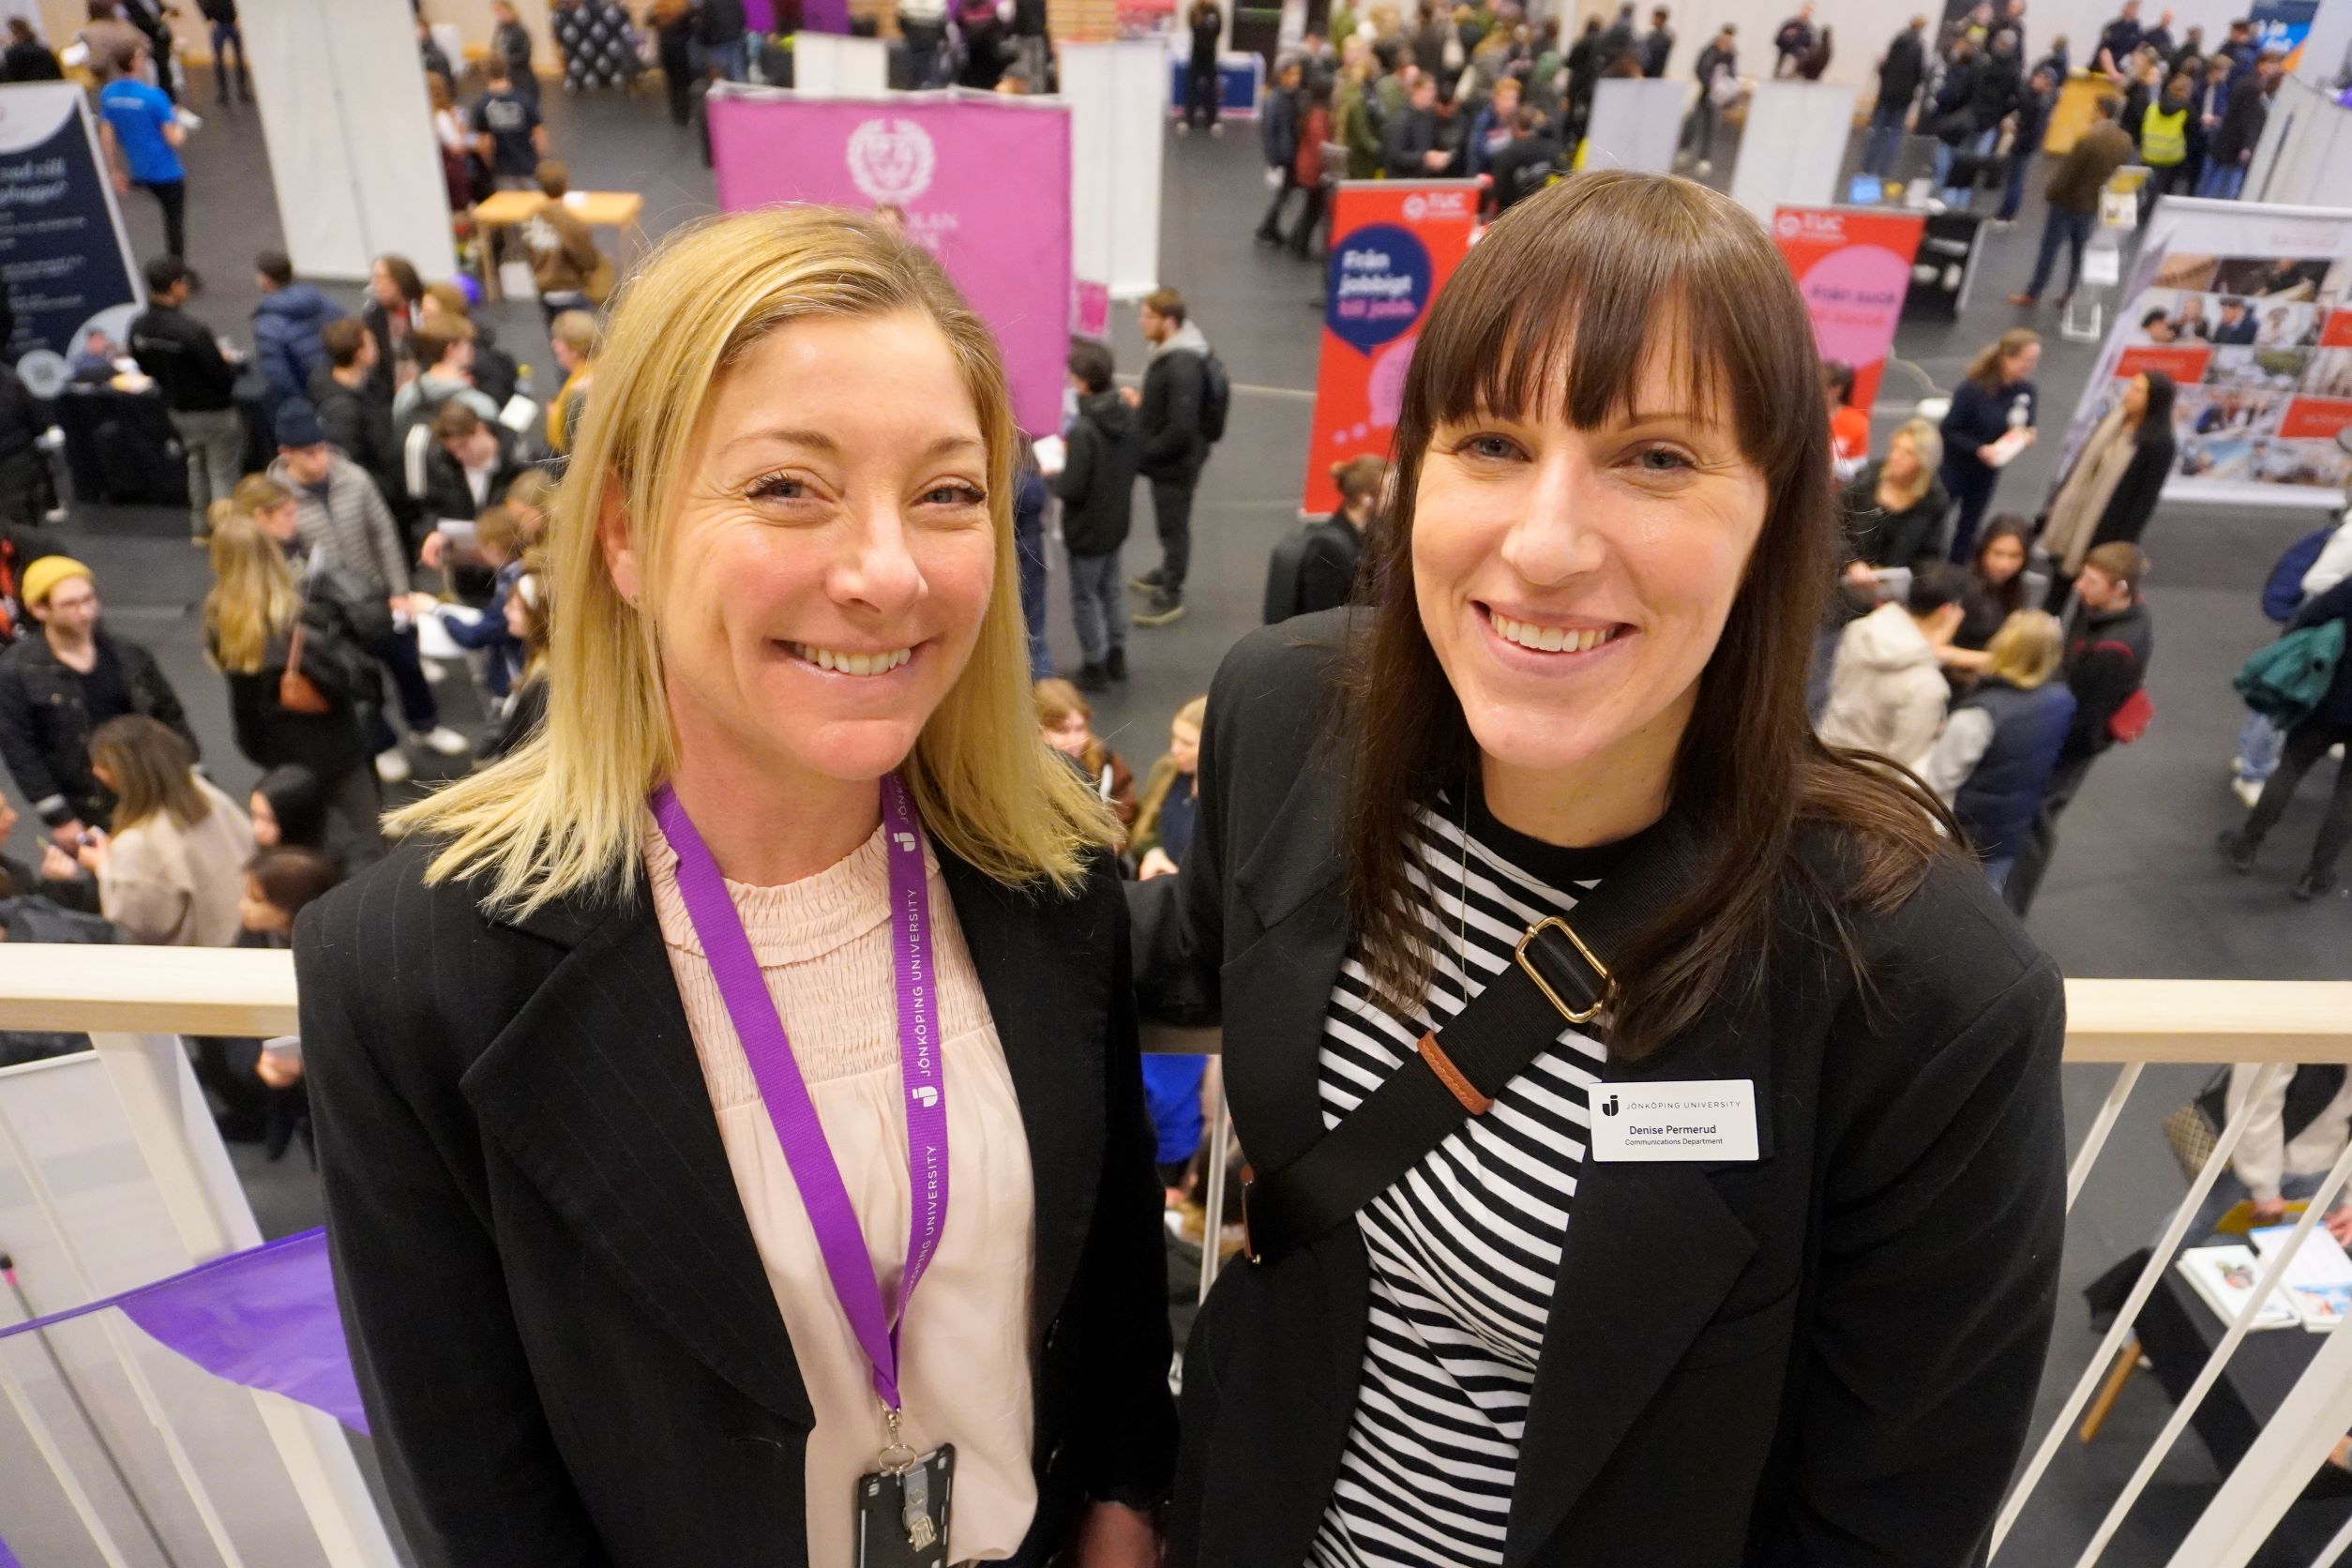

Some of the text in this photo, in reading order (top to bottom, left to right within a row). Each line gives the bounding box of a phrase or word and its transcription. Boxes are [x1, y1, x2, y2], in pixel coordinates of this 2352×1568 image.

[1342, 249, 1391, 270] Från
[1338, 273, 1412, 296] jobbigt
[908, 889, 930, 1077] JÖNKÖPING UNIVERSITY
[1626, 1101, 1681, 1109] JÖNKÖPING
[1629, 1124, 1717, 1135] Denise Permerud
[1682, 1138, 1724, 1146] Department
[925, 1146, 938, 1236] UNIVERSITY
